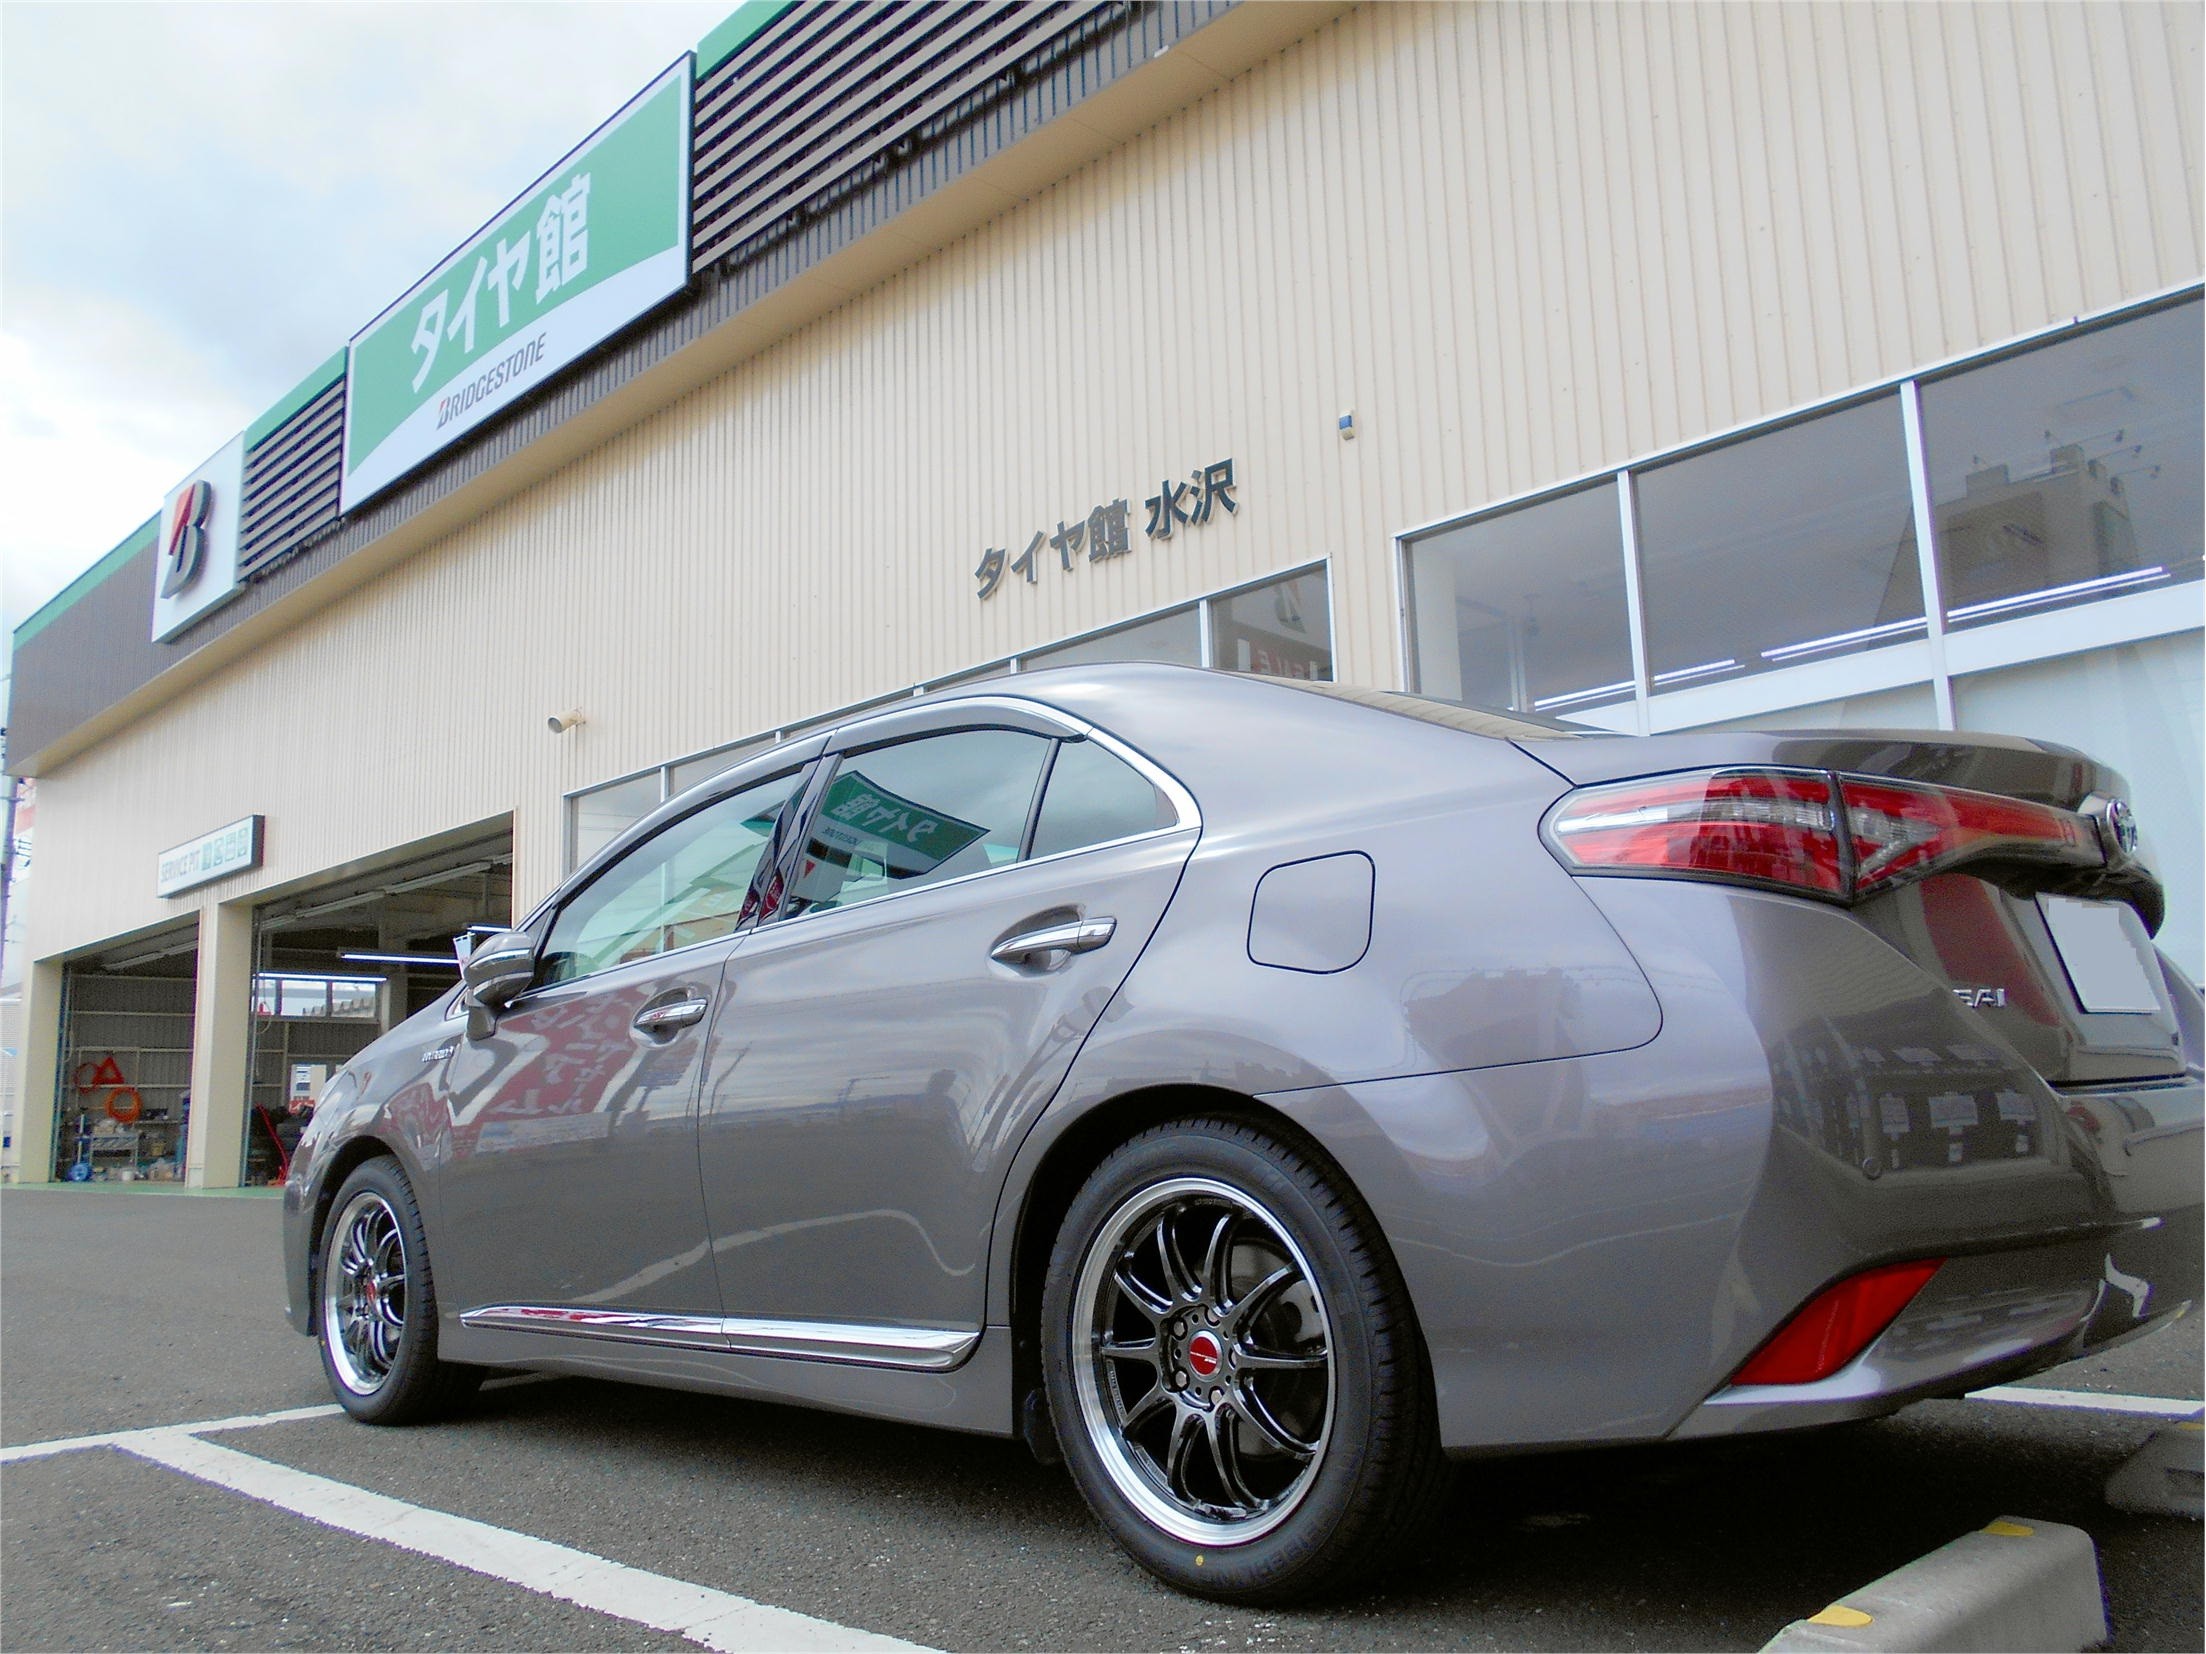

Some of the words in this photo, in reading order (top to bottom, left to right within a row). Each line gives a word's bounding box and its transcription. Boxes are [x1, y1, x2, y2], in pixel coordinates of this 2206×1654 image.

[411, 172, 591, 394] タイヤ館
[436, 332, 547, 431] BRIDGESTONE
[974, 497, 1133, 601] タイヤ館
[1144, 456, 1239, 541] 水沢
[1952, 988, 2005, 1008] SAI
